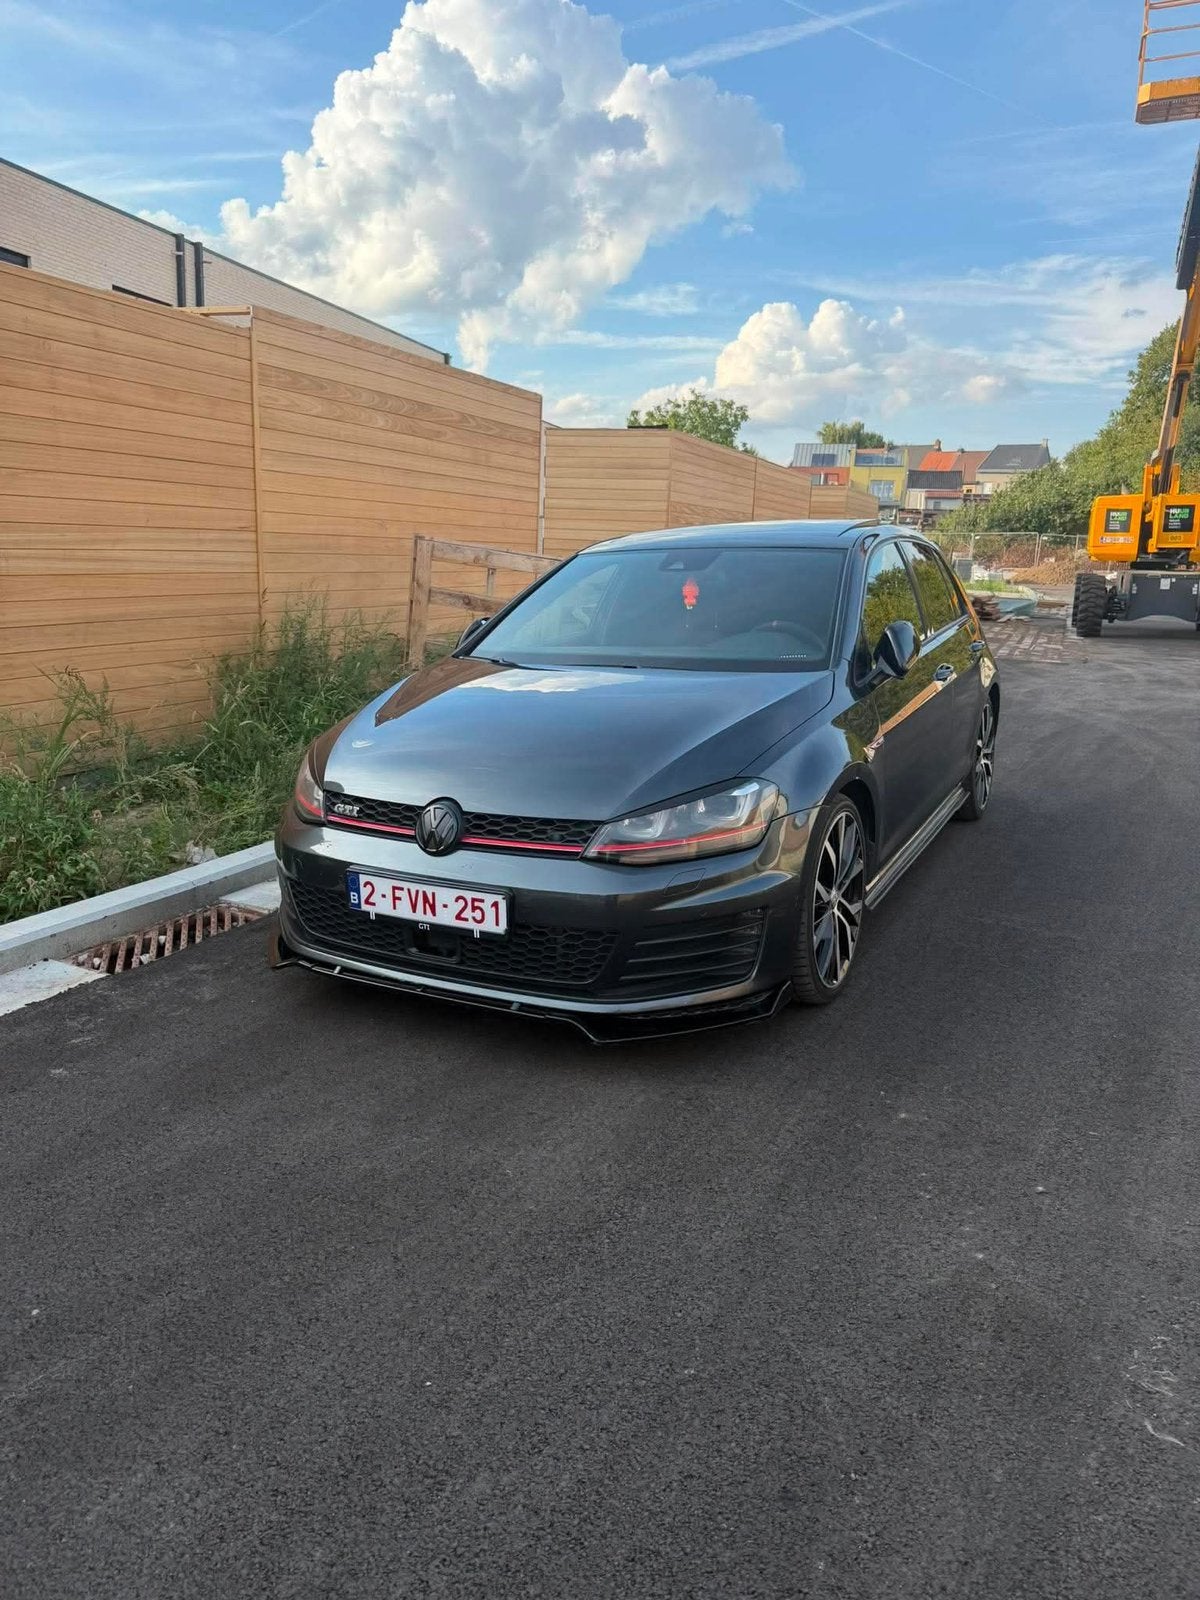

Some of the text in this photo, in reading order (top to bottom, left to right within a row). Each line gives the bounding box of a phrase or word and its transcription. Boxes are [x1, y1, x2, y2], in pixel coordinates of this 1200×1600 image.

[334, 803, 360, 817] GTI
[350, 891, 359, 904] B
[363, 880, 500, 927] 2-FVN-251
[418, 922, 430, 931] GTI
